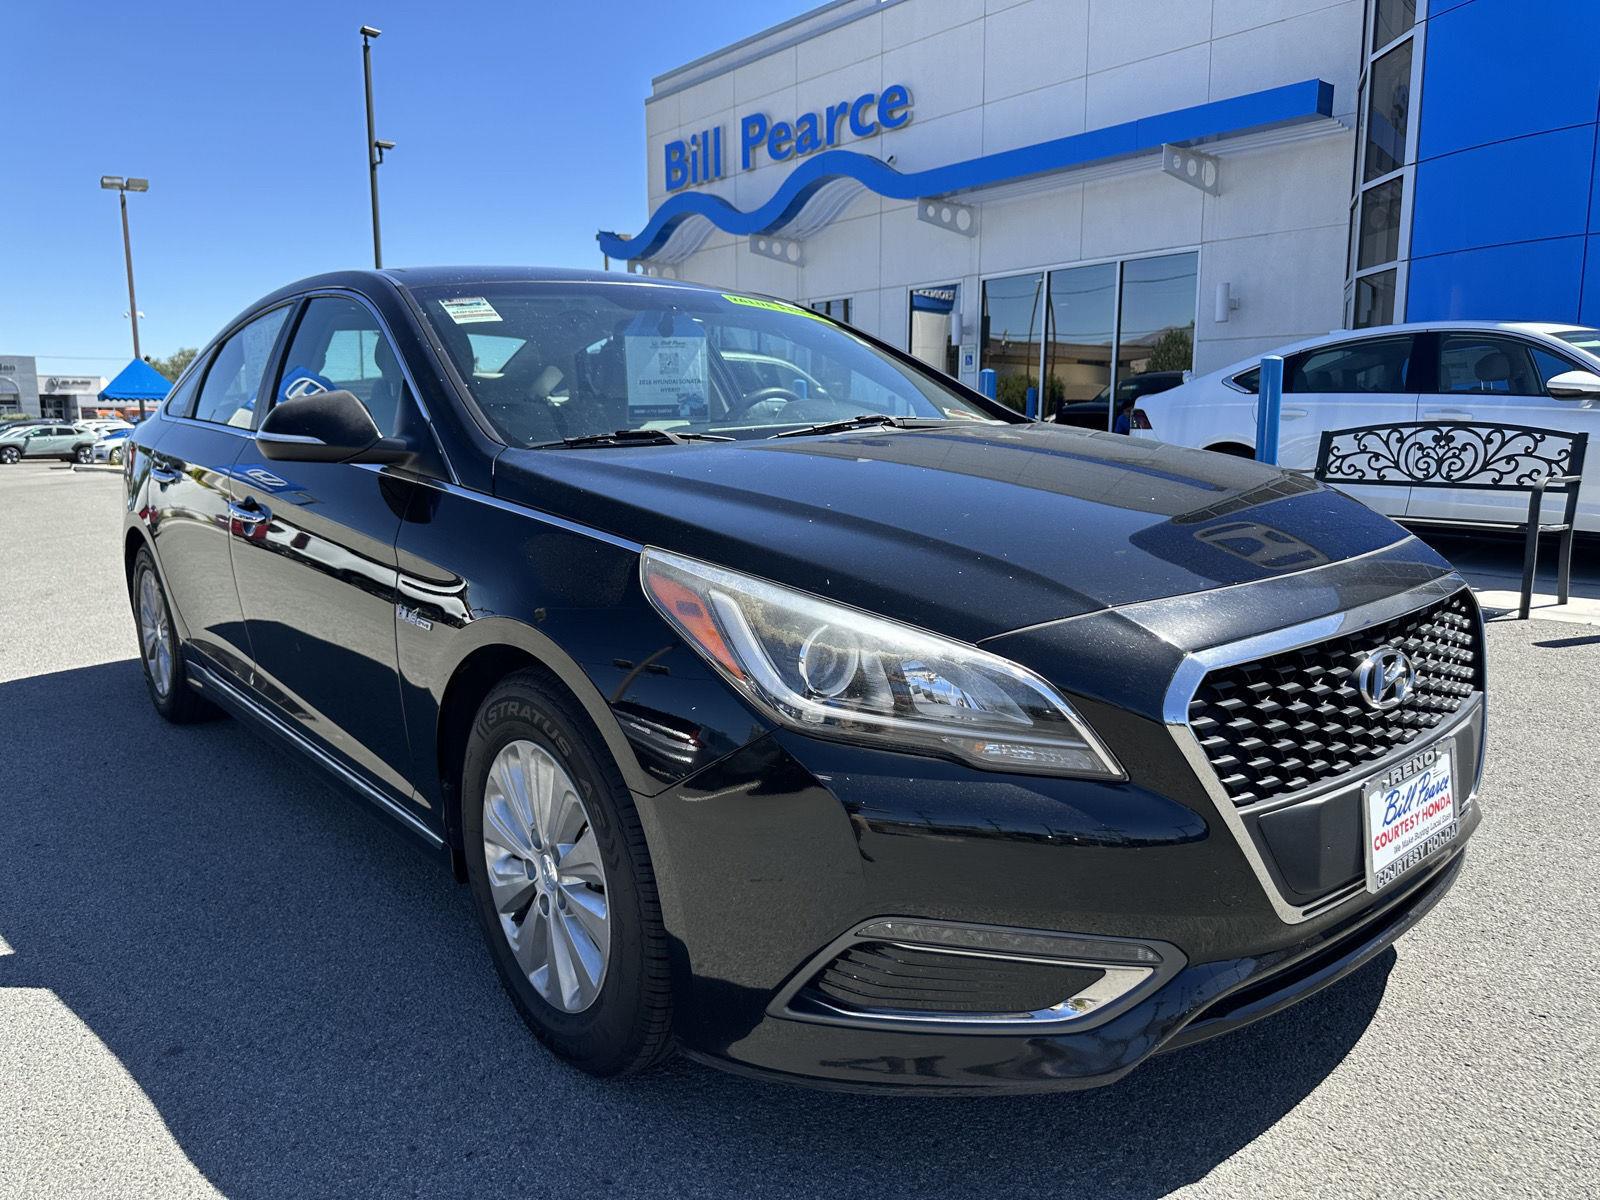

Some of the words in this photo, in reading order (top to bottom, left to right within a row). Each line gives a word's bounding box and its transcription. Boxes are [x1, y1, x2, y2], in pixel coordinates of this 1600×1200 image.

[665, 126, 723, 191] Bill
[741, 84, 911, 171] Pearce
[487, 701, 570, 757] STRATUS
[1390, 751, 1437, 786] RENO
[1374, 811, 1420, 851] COURTESY
[1422, 793, 1452, 820] HONDA
[1382, 785, 1417, 827] Bill
[1416, 771, 1449, 808] Pearce
[1376, 843, 1425, 889] COURTESY
[1426, 822, 1457, 853] HONDA
[1414, 827, 1430, 842] Buying
